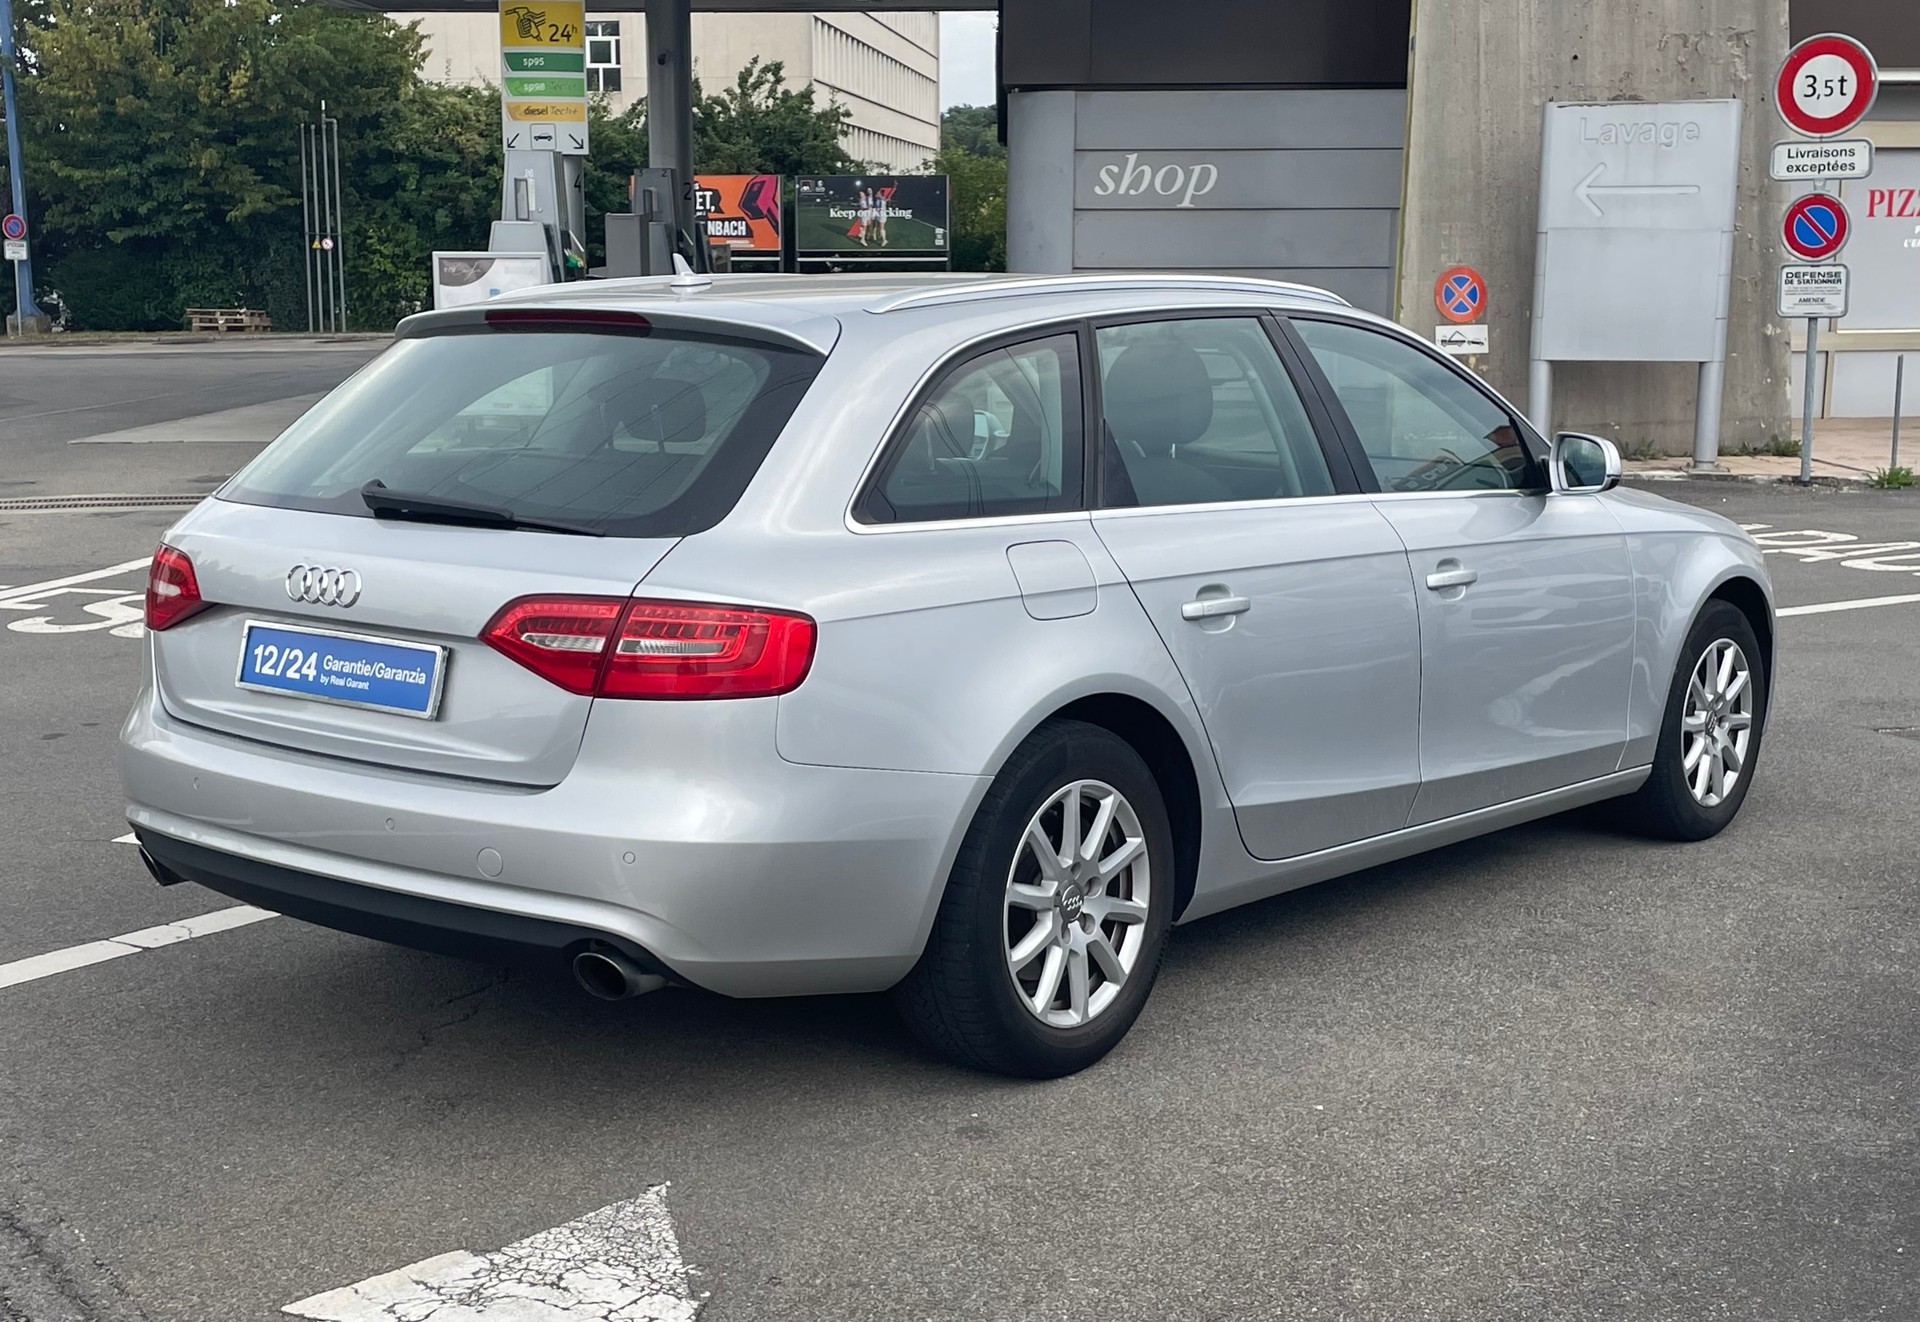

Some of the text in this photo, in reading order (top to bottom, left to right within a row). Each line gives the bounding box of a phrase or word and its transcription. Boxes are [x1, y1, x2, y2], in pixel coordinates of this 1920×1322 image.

[523, 57, 545, 67] sp95
[524, 82, 545, 92] sp98
[524, 106, 548, 115] diesel
[1580, 117, 1700, 150] Lavage
[1787, 147, 1856, 159] Livraisons
[1786, 160, 1856, 174] exceptées
[573, 174, 581, 193] 4
[1094, 153, 1218, 207] shop
[683, 182, 692, 200] 2
[1866, 188, 1920, 217] PIZ
[829, 207, 912, 219] Keep on Kicking
[1786, 271, 1842, 279] DEFENSE
[253, 643, 319, 681] 12/24
[323, 655, 427, 685] Garantie/Garanzia
[320, 673, 370, 690] by Real Garant
